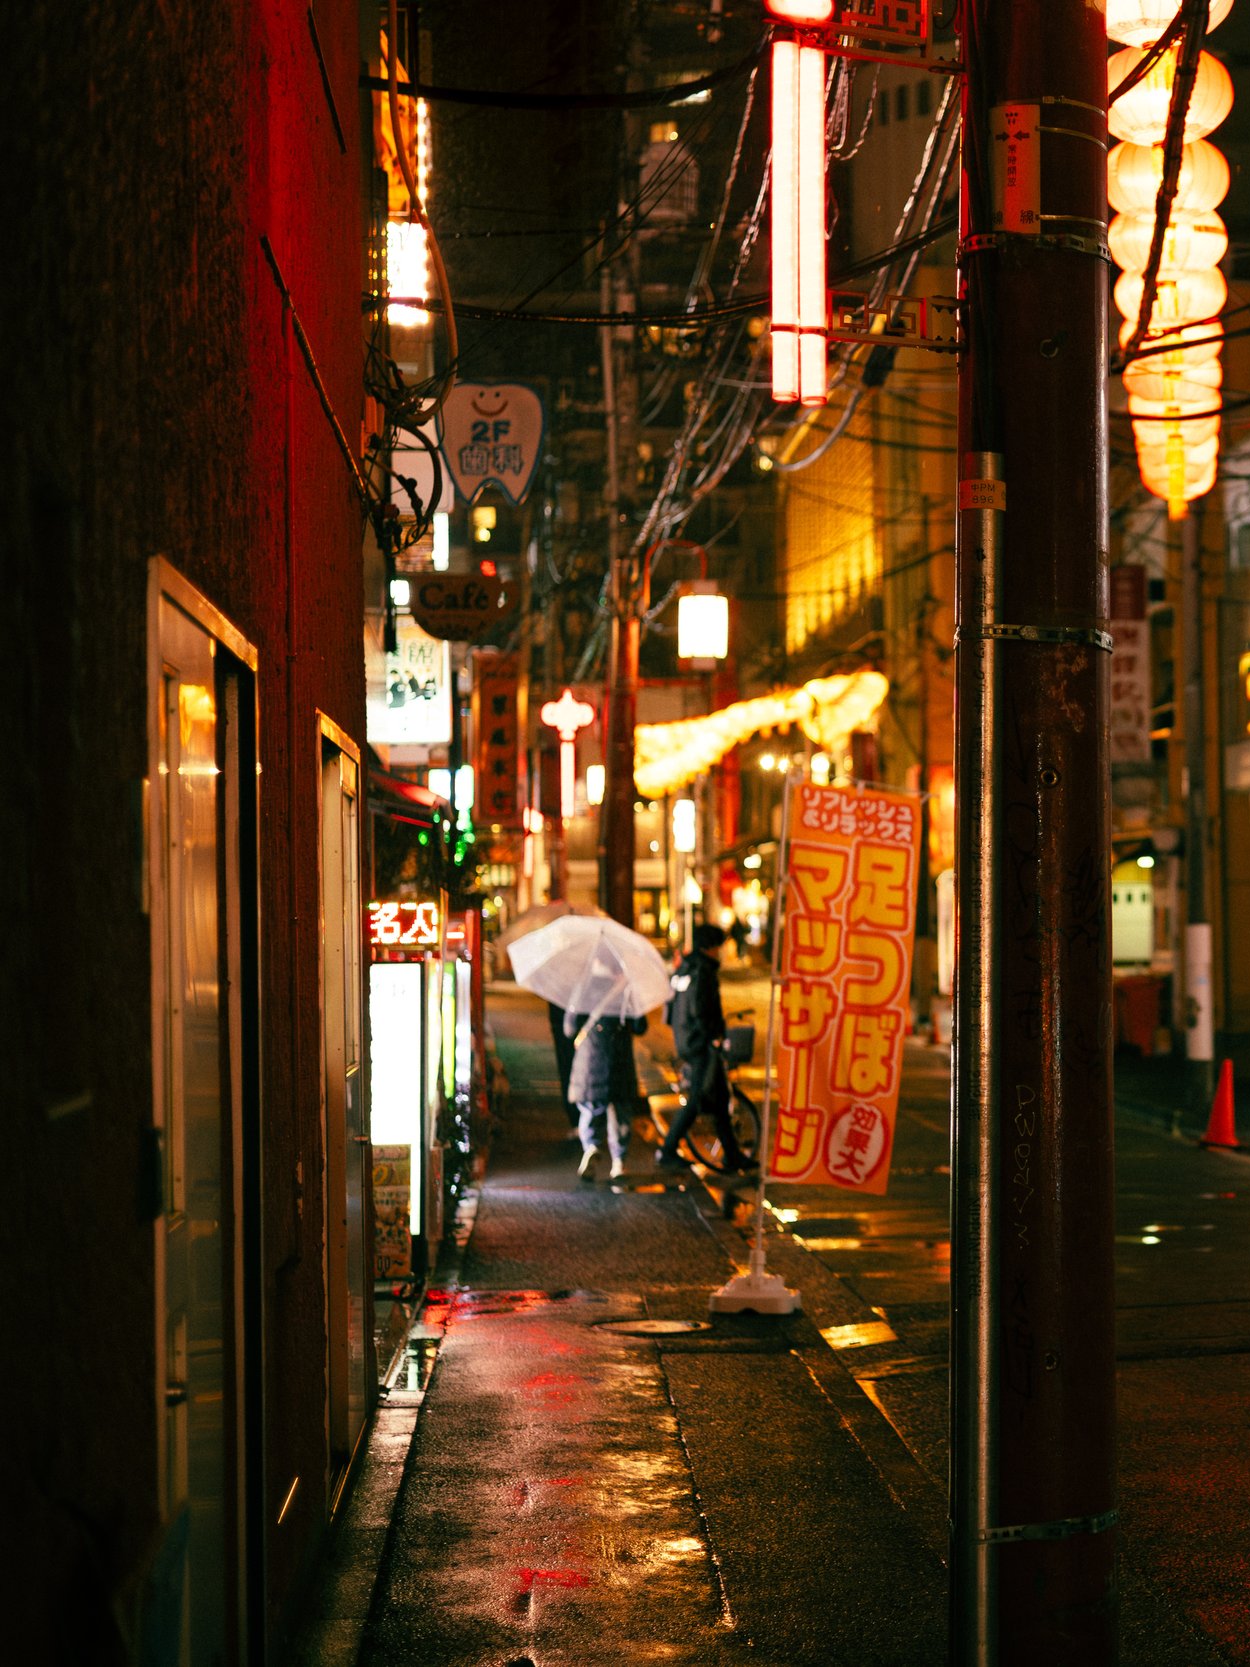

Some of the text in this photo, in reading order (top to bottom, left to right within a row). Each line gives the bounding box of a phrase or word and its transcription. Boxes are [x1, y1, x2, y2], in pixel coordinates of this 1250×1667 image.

[471, 421, 511, 442] 2F
[802, 786, 914, 824] リフレッシュ
[772, 843, 850, 1179] マッサージ
[831, 840, 912, 1099] 足つぼ
